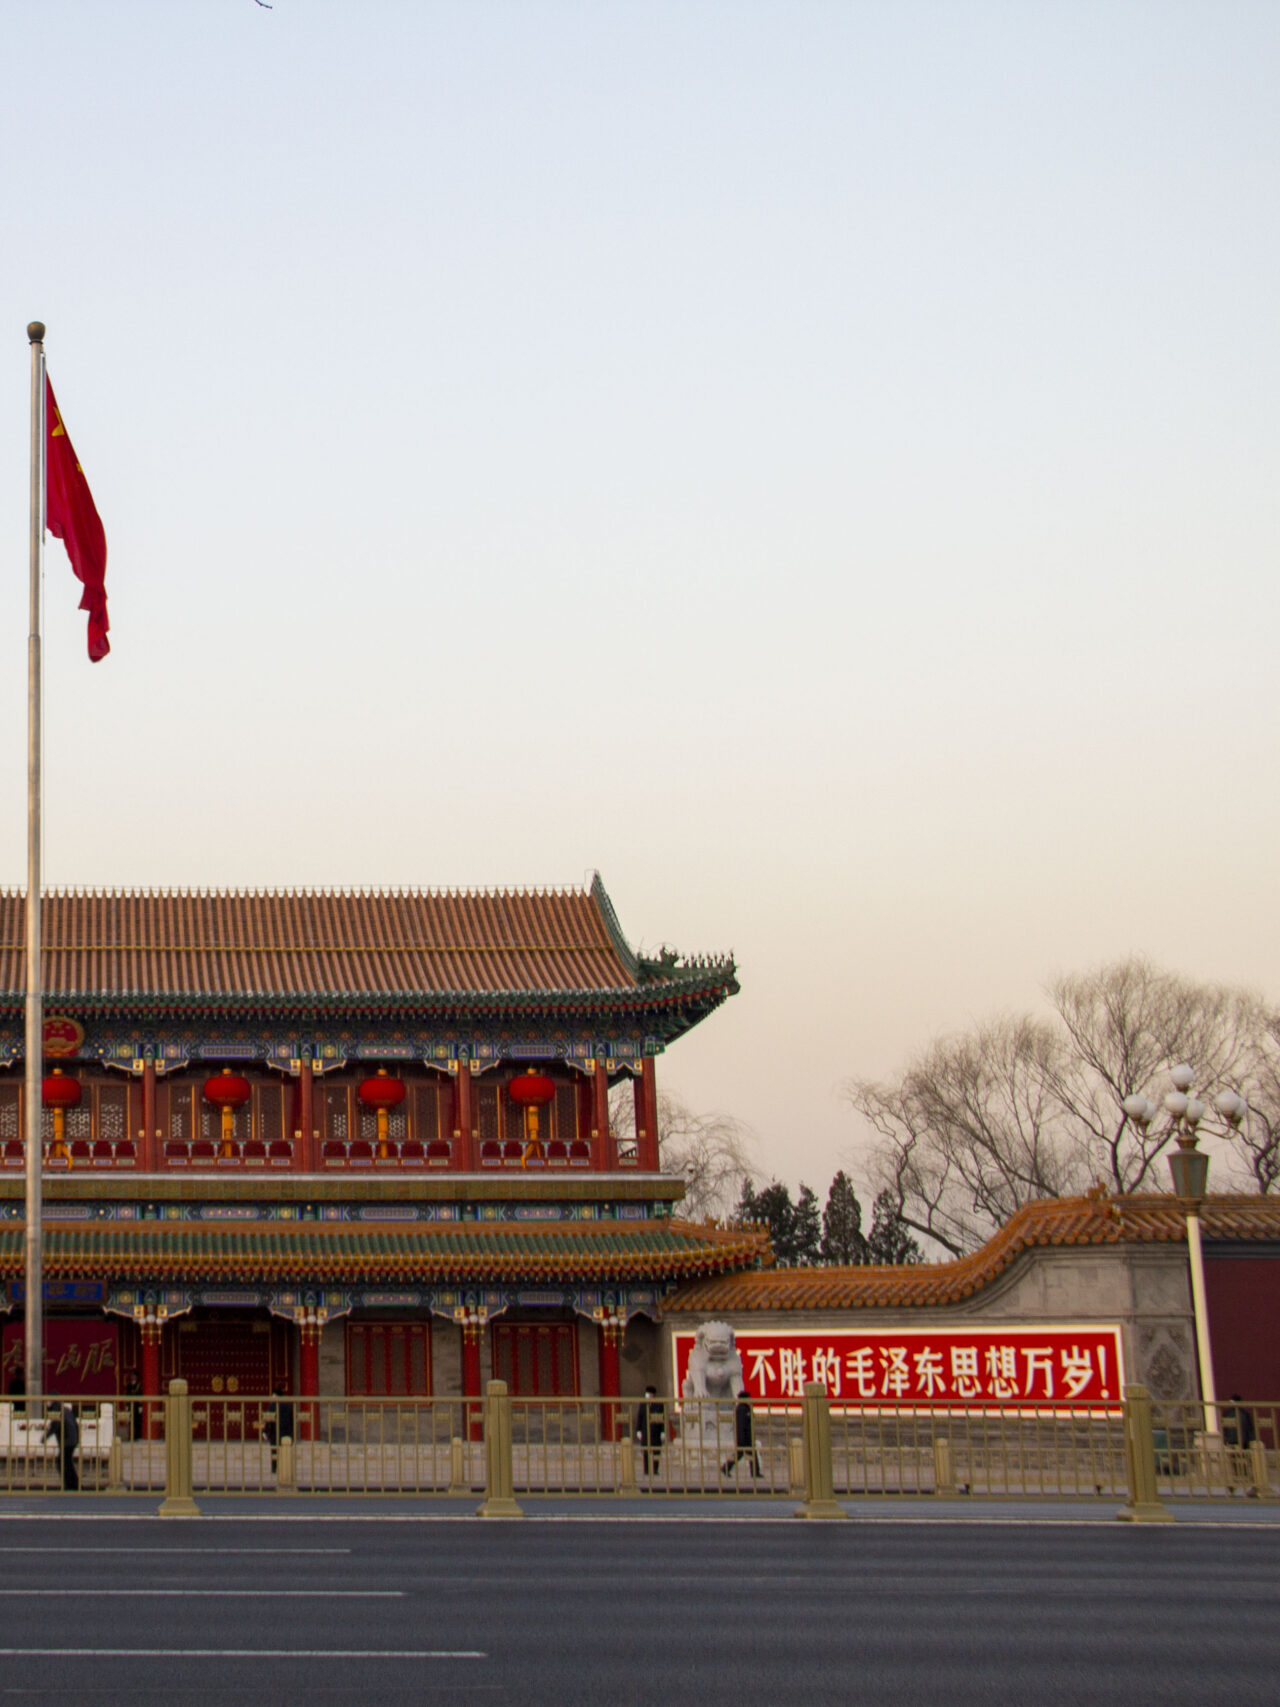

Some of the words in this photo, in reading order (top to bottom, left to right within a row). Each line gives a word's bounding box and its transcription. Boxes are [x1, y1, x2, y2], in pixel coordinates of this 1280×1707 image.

[684, 1345, 1110, 1398] 不胜的毛泽东思想万岁!
